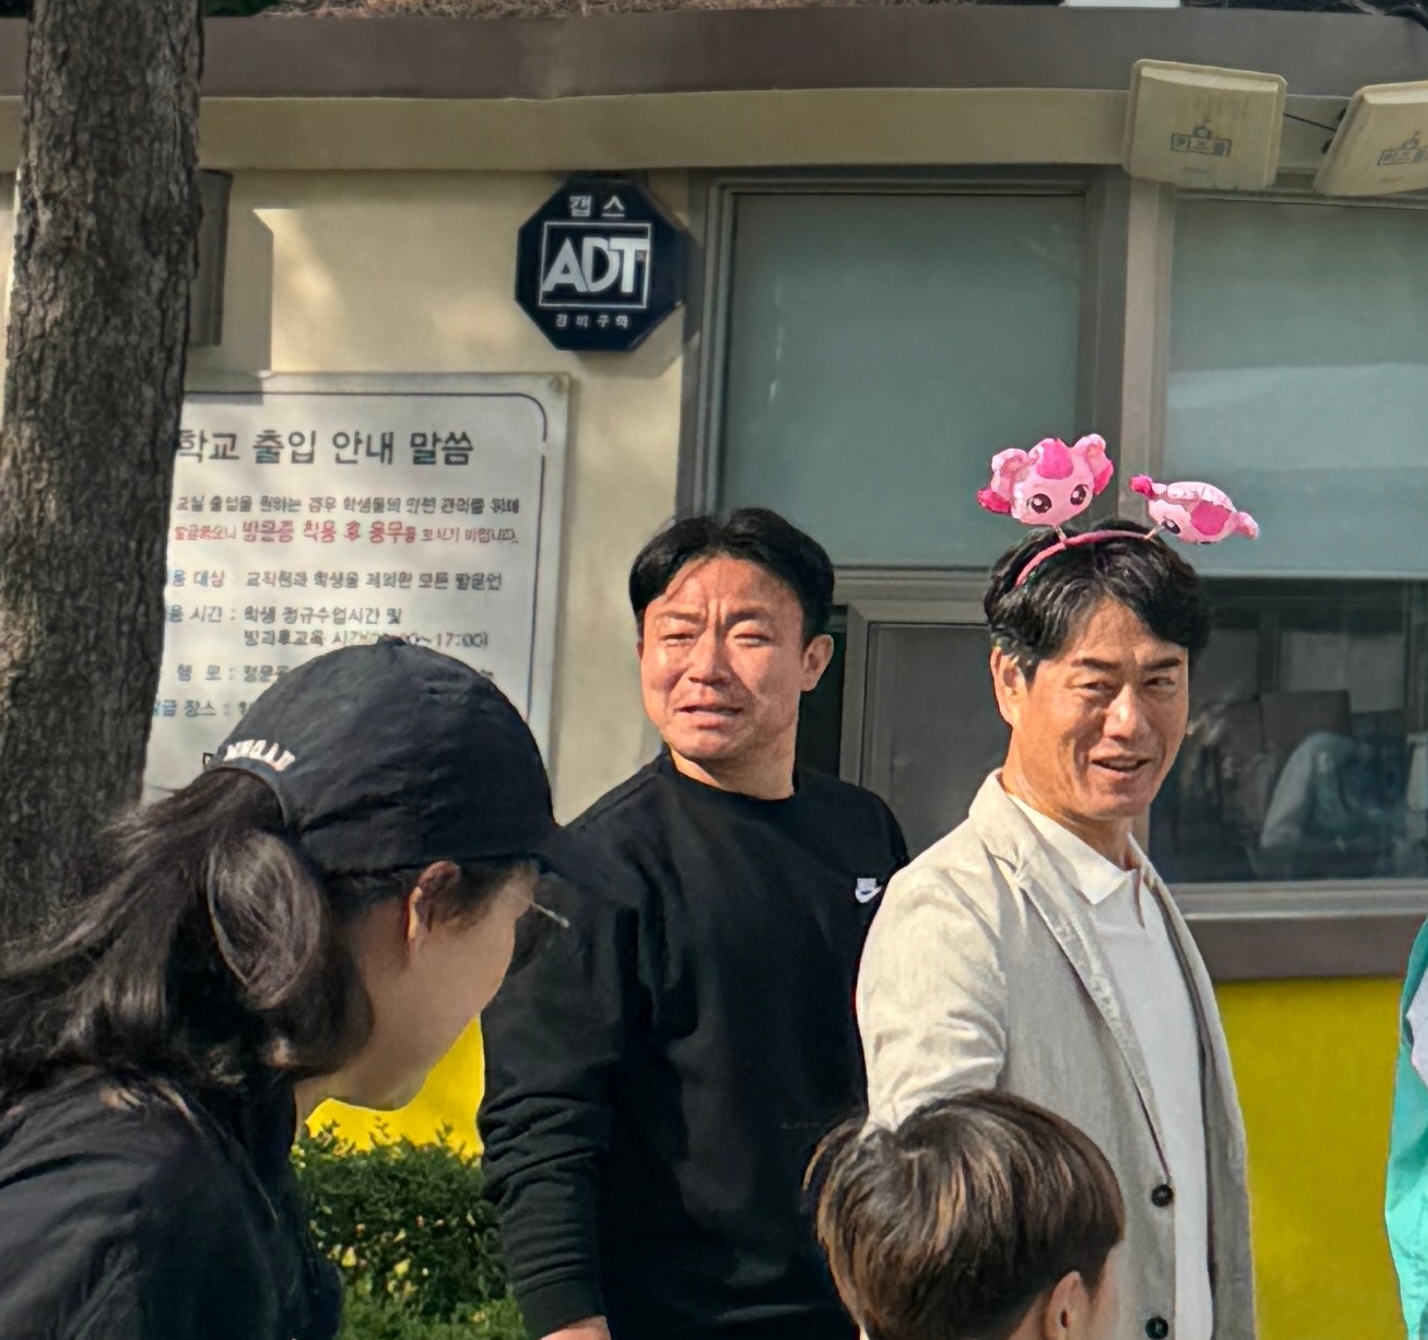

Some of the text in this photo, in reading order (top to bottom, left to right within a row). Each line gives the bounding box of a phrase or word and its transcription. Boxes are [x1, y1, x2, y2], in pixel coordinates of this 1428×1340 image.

[541, 236, 650, 293] ADT
[178, 429, 474, 465] 학교 출입 안내 말씀
[190, 605, 223, 623] 시간
